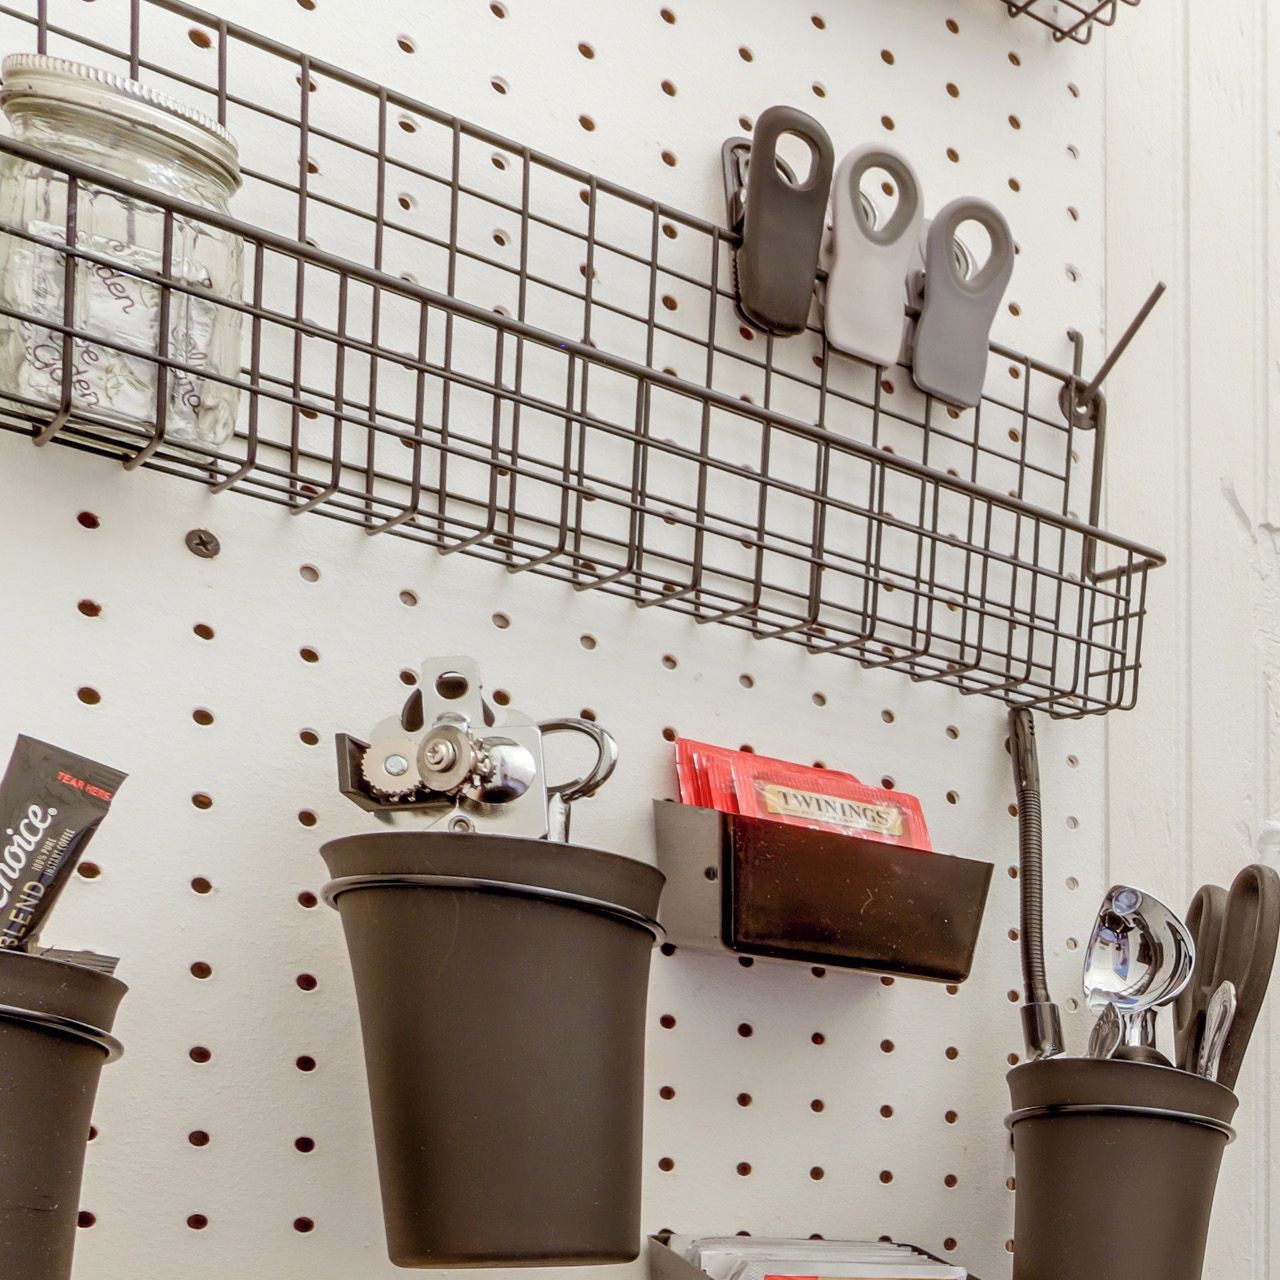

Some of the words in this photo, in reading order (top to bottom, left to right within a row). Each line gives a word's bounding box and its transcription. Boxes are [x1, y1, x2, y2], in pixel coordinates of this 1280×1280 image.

[33, 343, 100, 408] Gaden
[56, 771, 84, 790] TEAR
[777, 790, 889, 825] TWININGS
[32, 851, 48, 872] 100%
[43, 836, 57, 856] PURE
[46, 849, 65, 877] INSTANT
[59, 828, 76, 851] COFFEE
[0, 881, 45, 948] BLEND
